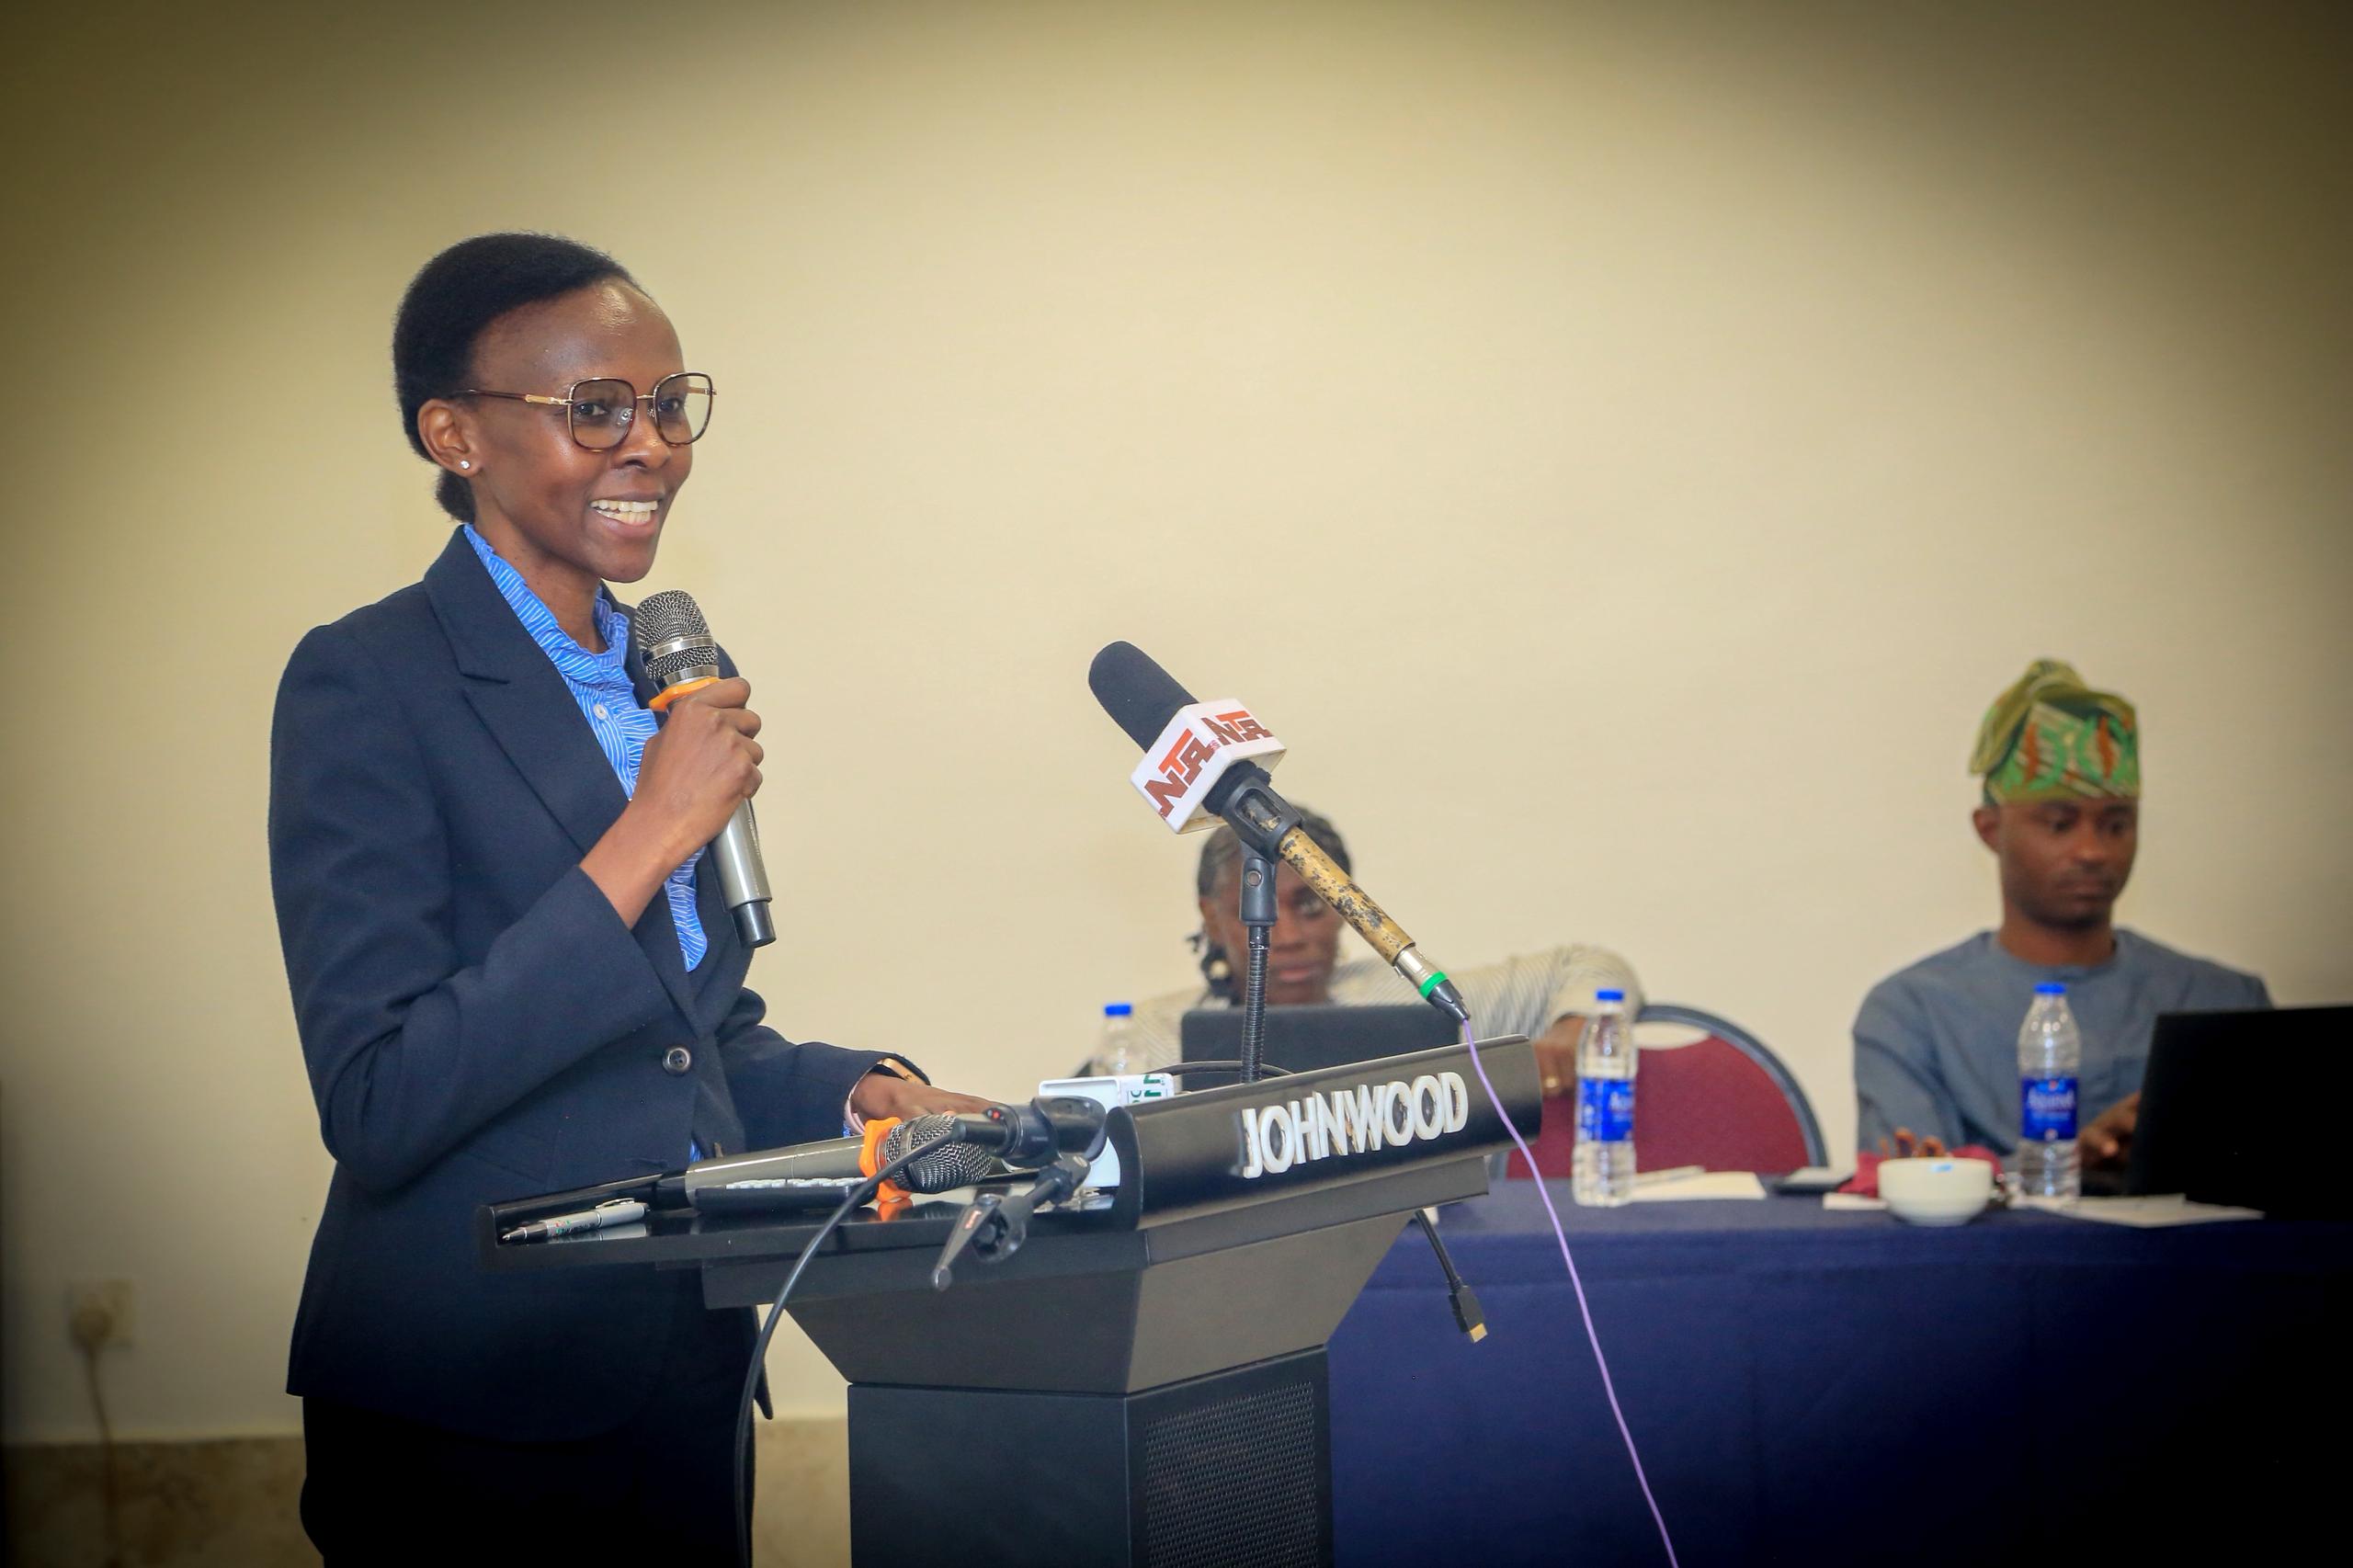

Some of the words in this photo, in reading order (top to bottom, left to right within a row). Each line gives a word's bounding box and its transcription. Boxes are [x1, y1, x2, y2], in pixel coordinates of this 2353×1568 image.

[1200, 710, 1274, 745] NTA
[1144, 728, 1218, 820] NTA
[1242, 1072, 1468, 1178] JOHNWOOD
